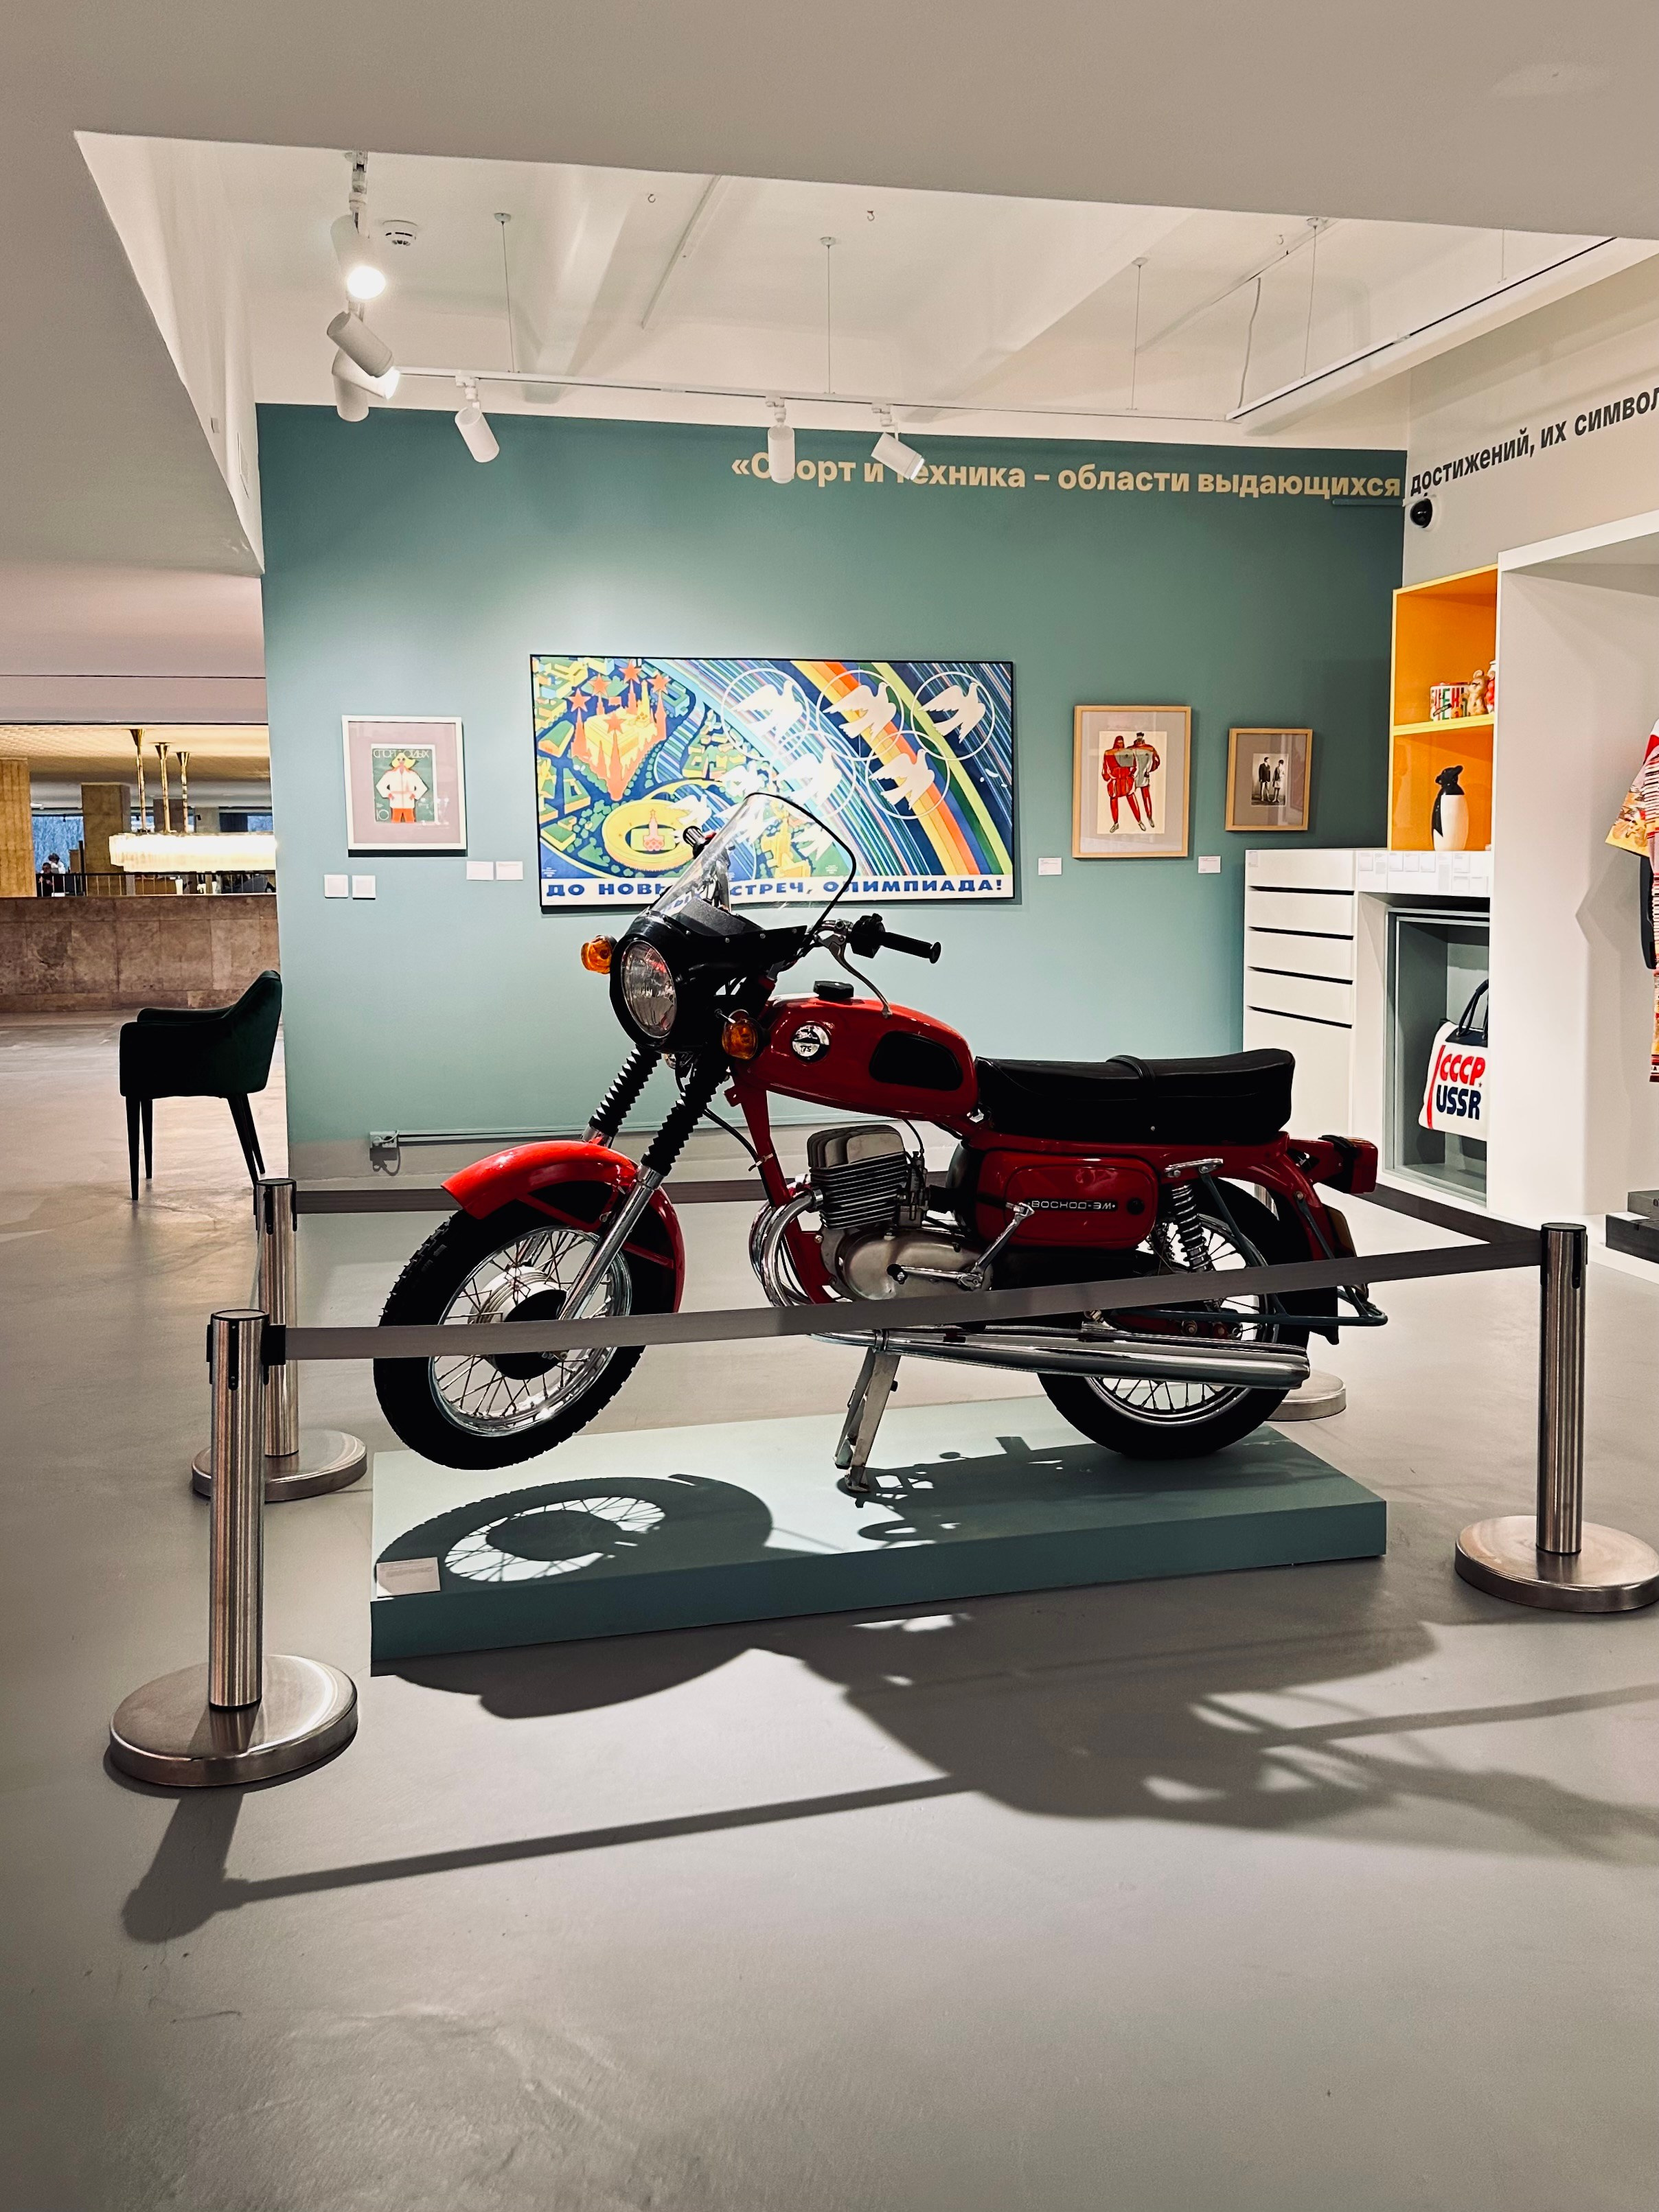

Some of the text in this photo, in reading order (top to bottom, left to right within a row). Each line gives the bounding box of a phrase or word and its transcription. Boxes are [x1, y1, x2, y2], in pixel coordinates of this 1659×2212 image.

[1410, 427, 1535, 497] достижений,
[1540, 420, 1567, 449] их
[731, 452, 856, 487] «Сорт
[864, 463, 884, 483] и
[896, 463, 1026, 488] ехника
[1057, 463, 1189, 492] области
[1198, 473, 1400, 500] выдающихся
[376, 809, 389, 820] 10
[547, 884, 585, 897] ДО
[730, 882, 813, 896] СТРЕЧ,
[823, 879, 1002, 892] ОЛИМПИАДА!
[1439, 1053, 1486, 1086] СССР
[1436, 1085, 1482, 1120] USSR
